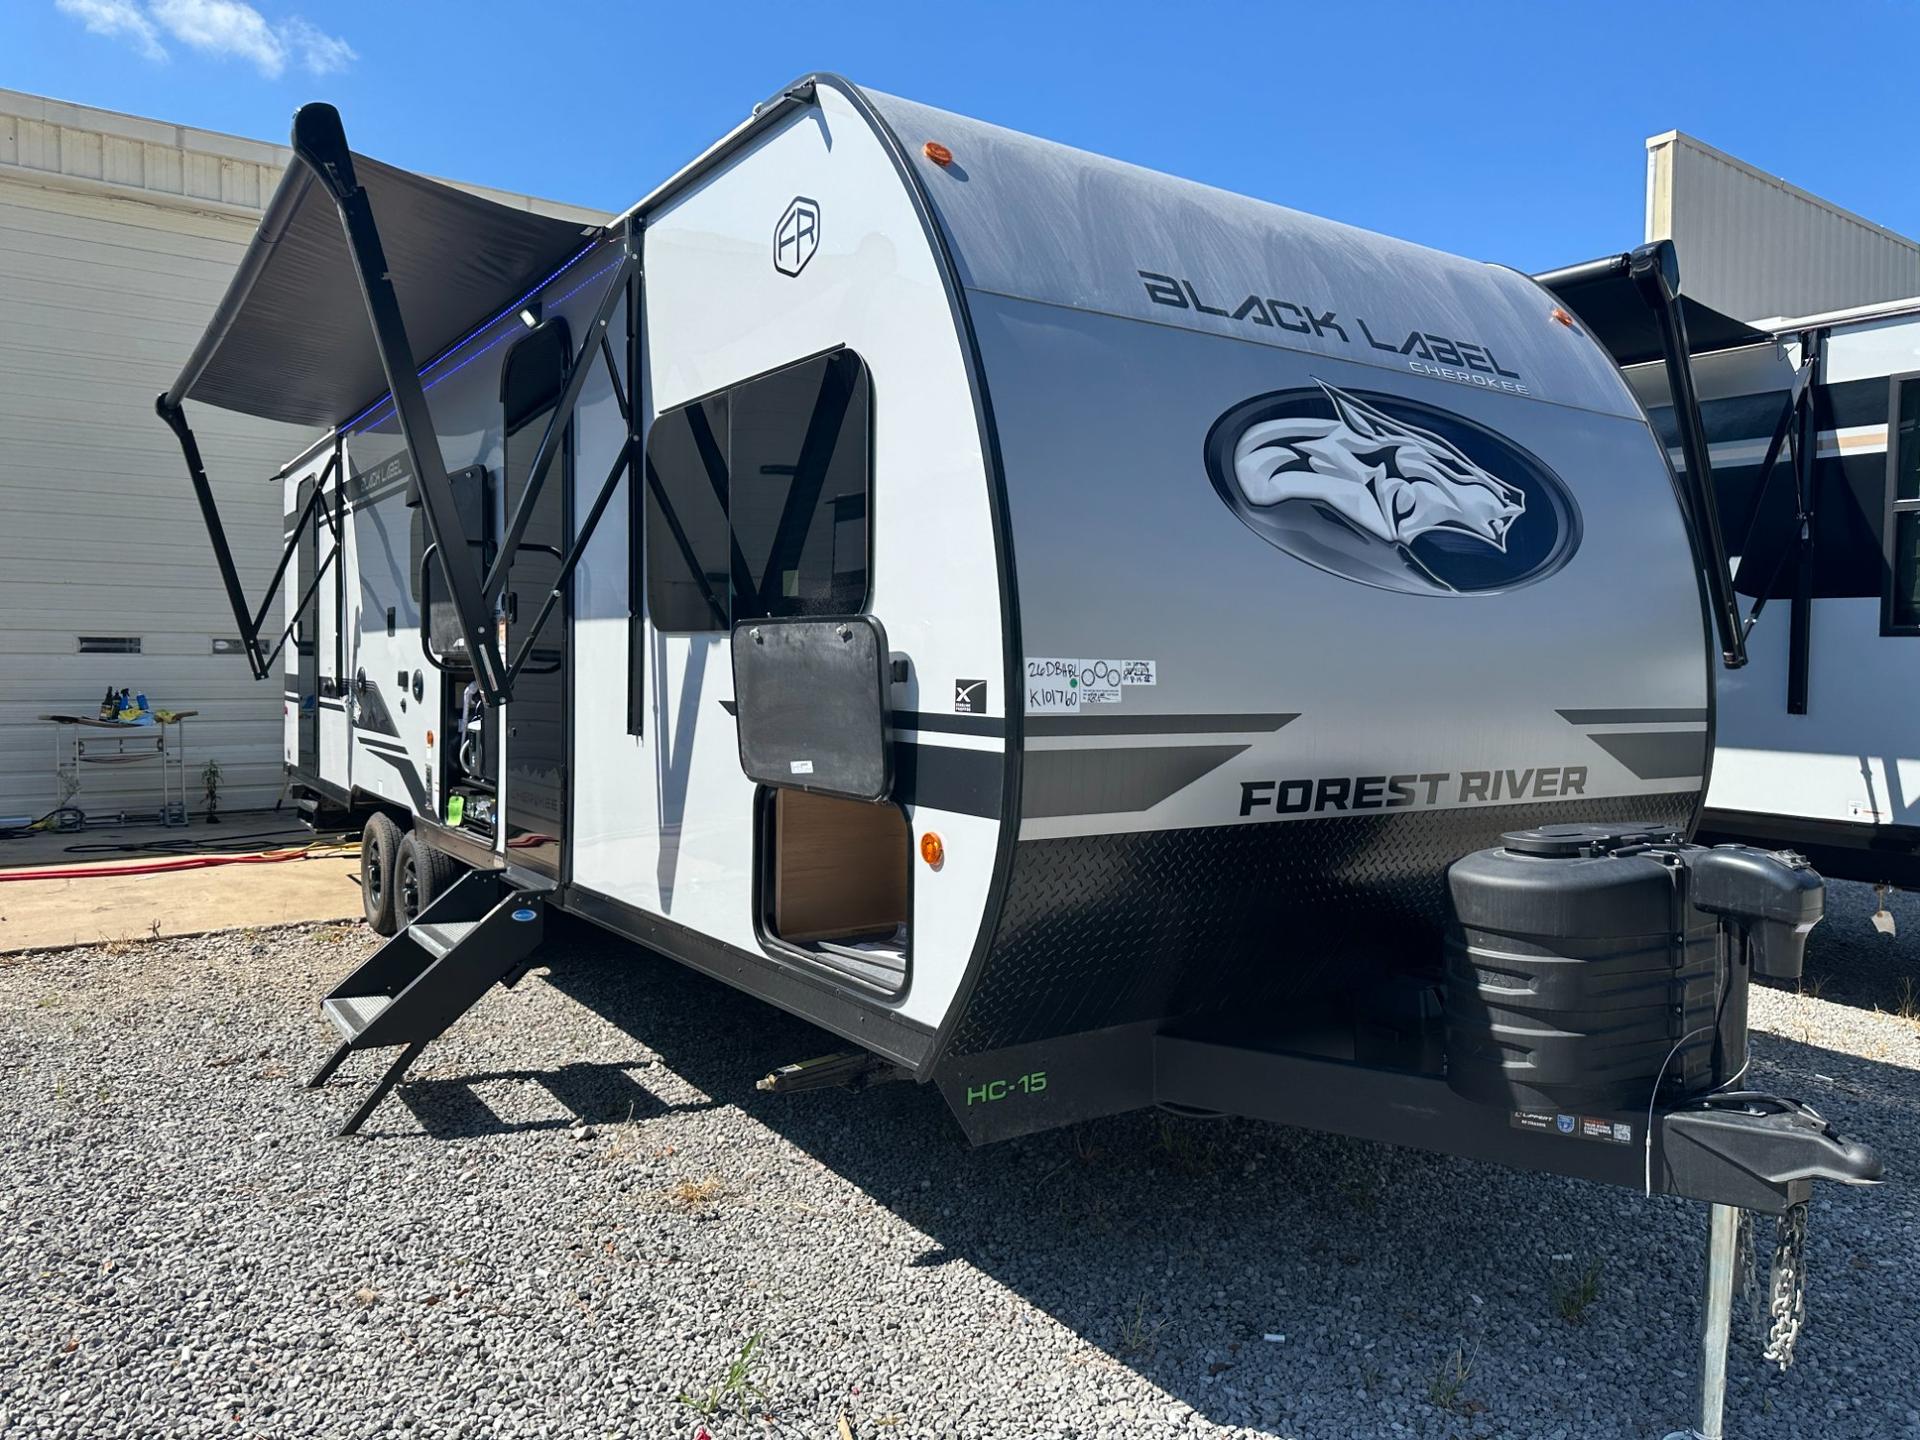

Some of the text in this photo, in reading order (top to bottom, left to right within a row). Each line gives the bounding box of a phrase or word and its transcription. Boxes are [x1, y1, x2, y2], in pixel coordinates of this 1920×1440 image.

[1137, 270, 1520, 380] BLACK LABEL
[1408, 361, 1530, 395] CHEROKEE
[1239, 766, 1588, 816] FOREST RIVER
